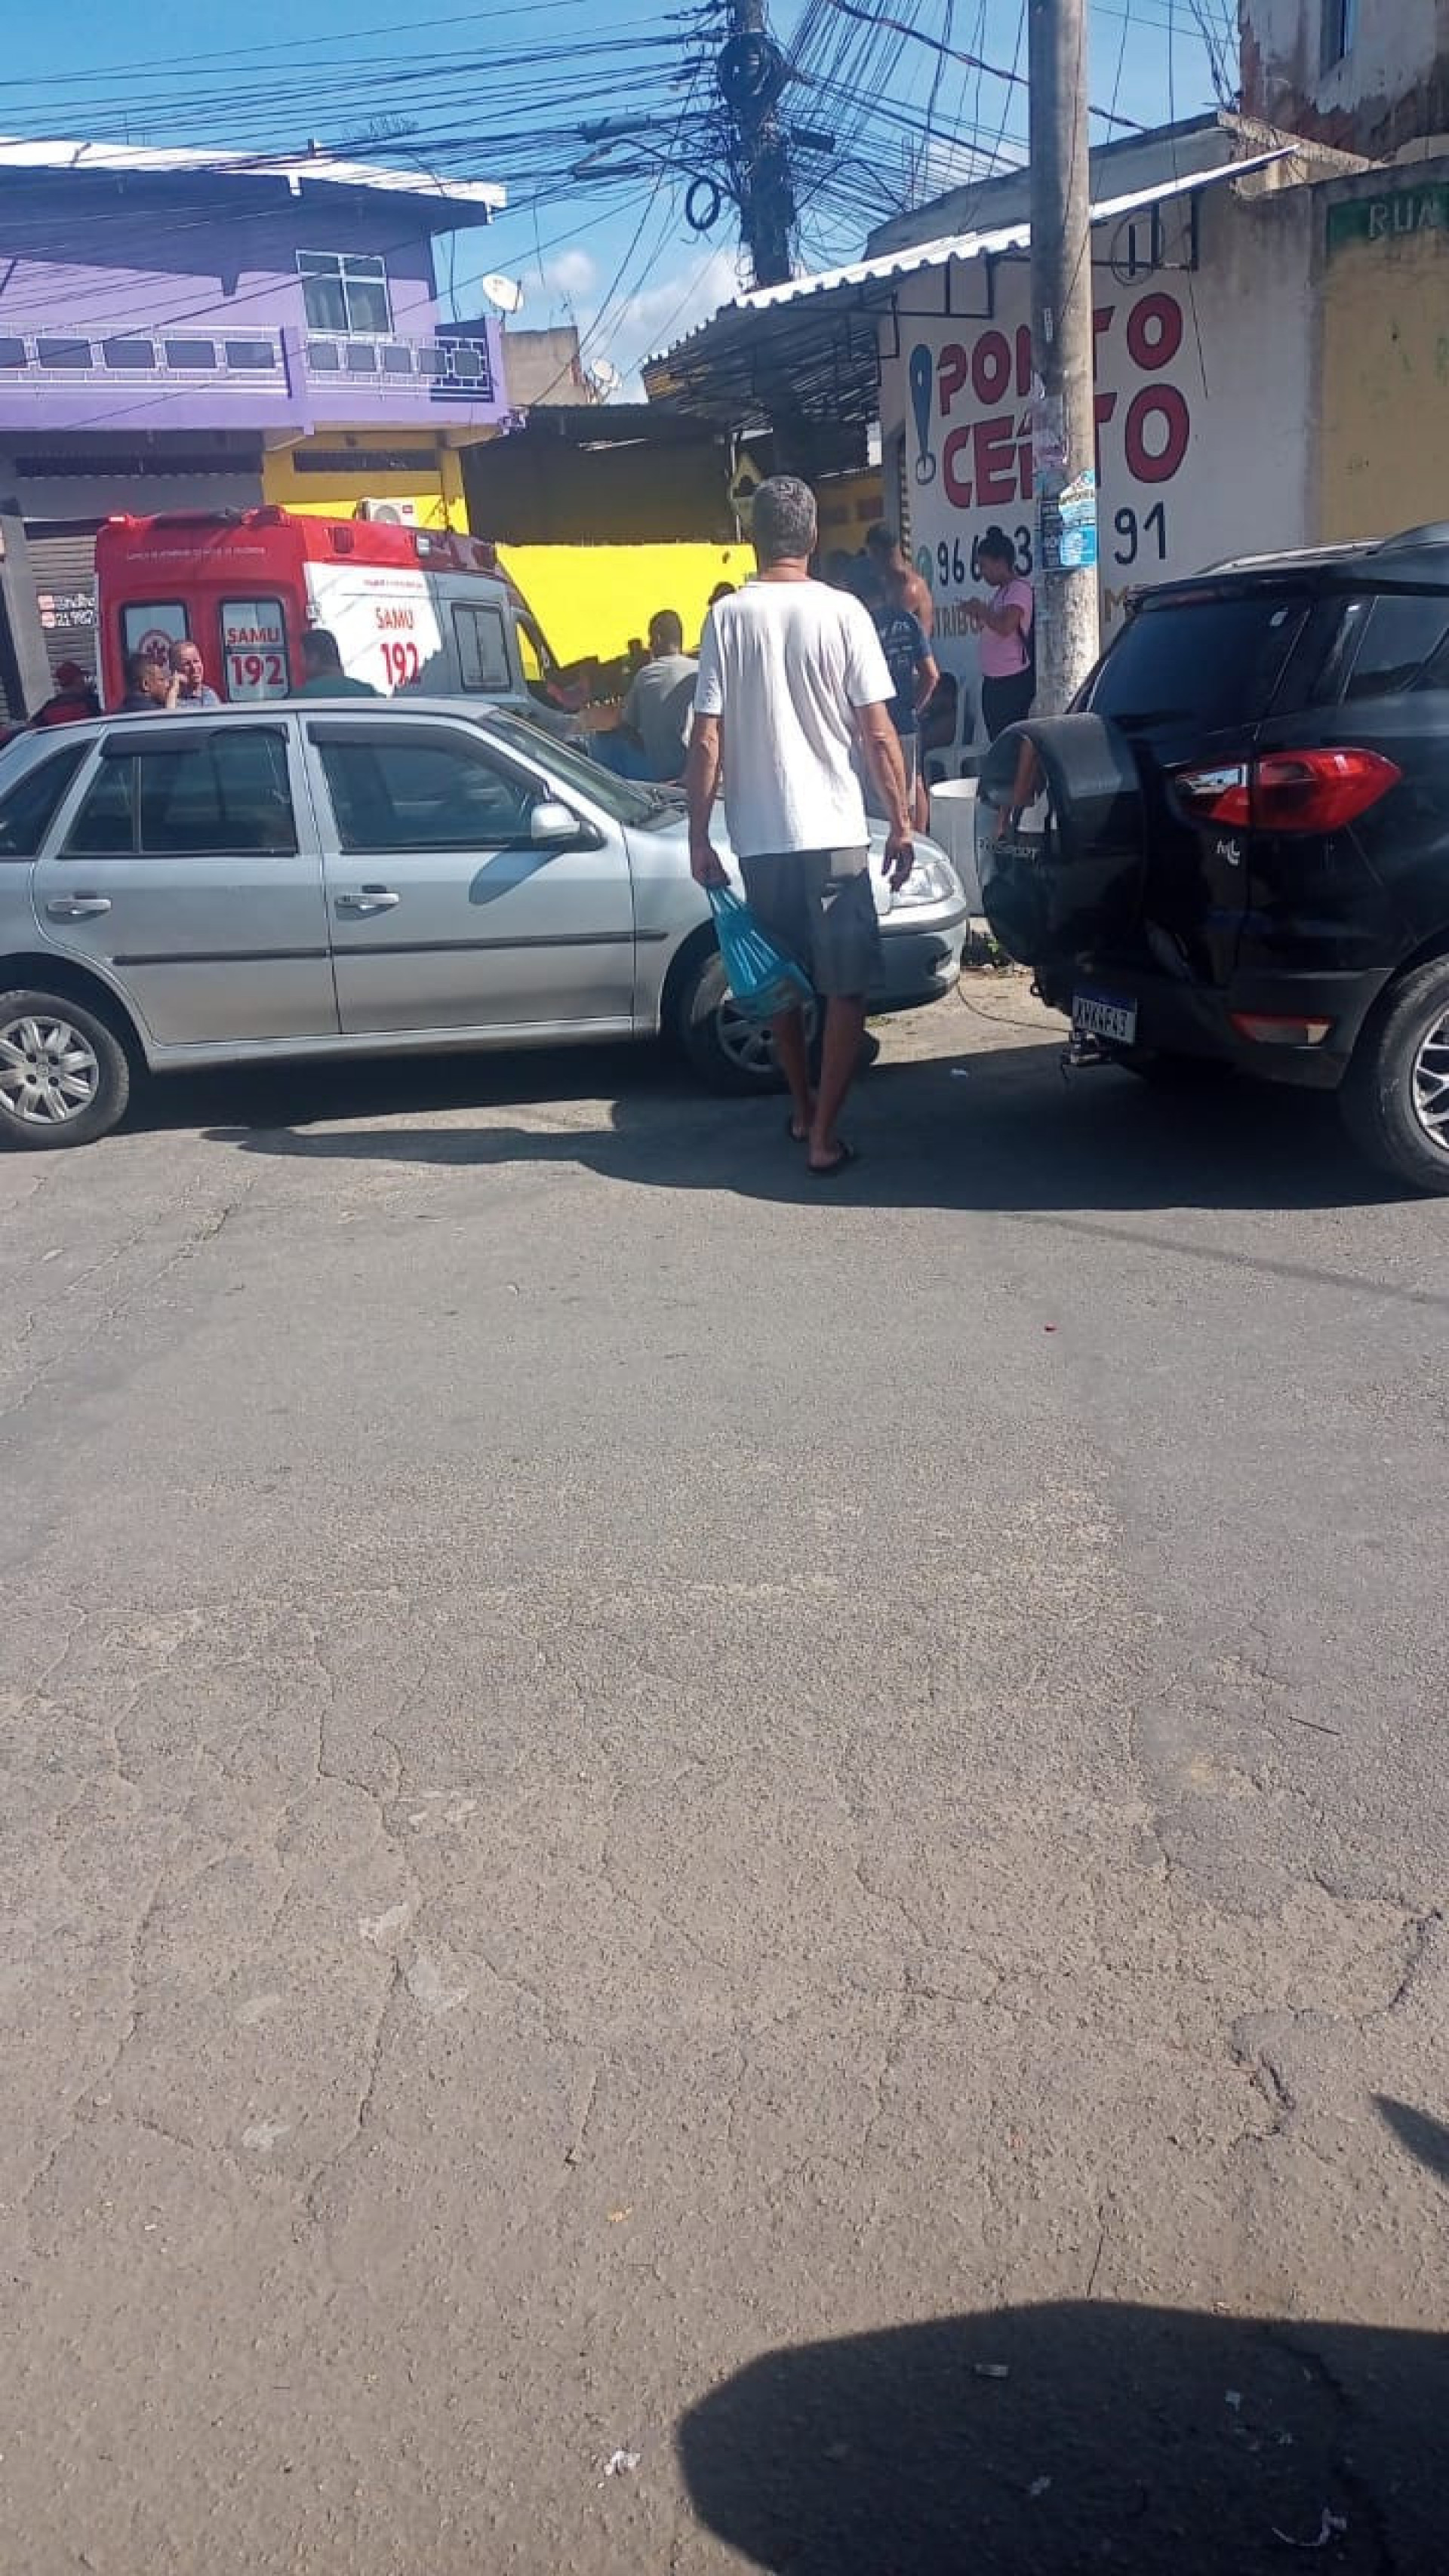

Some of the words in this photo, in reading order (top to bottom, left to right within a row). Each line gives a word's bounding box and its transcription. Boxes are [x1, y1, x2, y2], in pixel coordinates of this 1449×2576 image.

[1369, 197, 1440, 239] RUA
[376, 606, 414, 629] SAMU
[226, 628, 279, 644] SAMU
[231, 656, 285, 686] 192
[380, 642, 422, 686] 192
